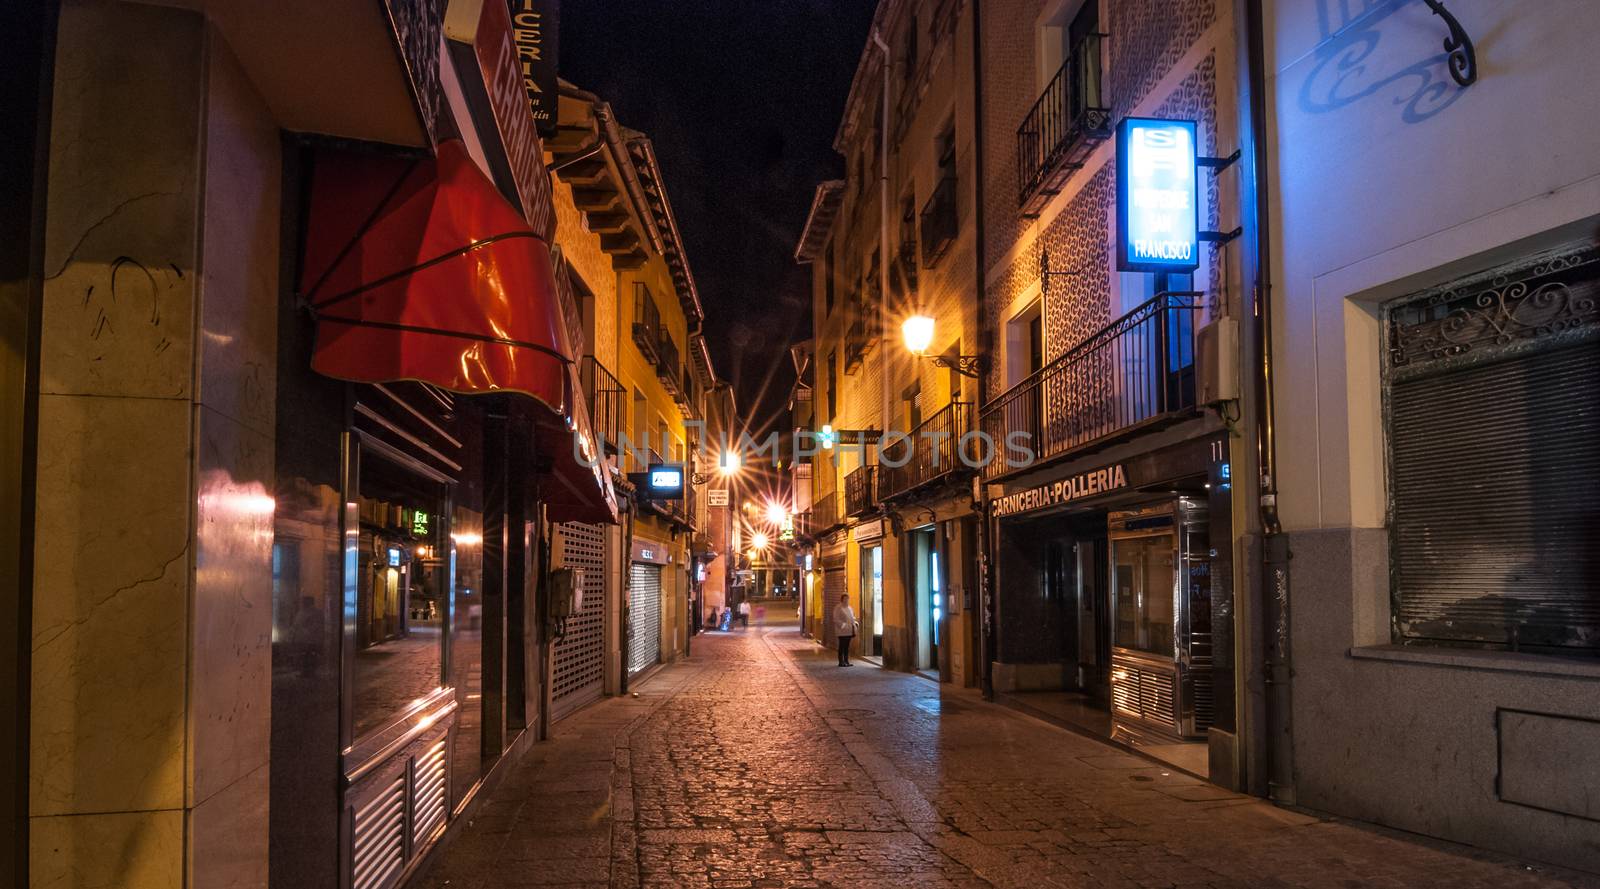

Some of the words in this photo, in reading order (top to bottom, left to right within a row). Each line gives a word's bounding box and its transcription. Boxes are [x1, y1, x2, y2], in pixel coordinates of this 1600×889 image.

[1134, 240, 1190, 259] FRANCISCO
[1210, 440, 1222, 462] 11
[992, 464, 1127, 517] CARNICERIA-POLLERIA
